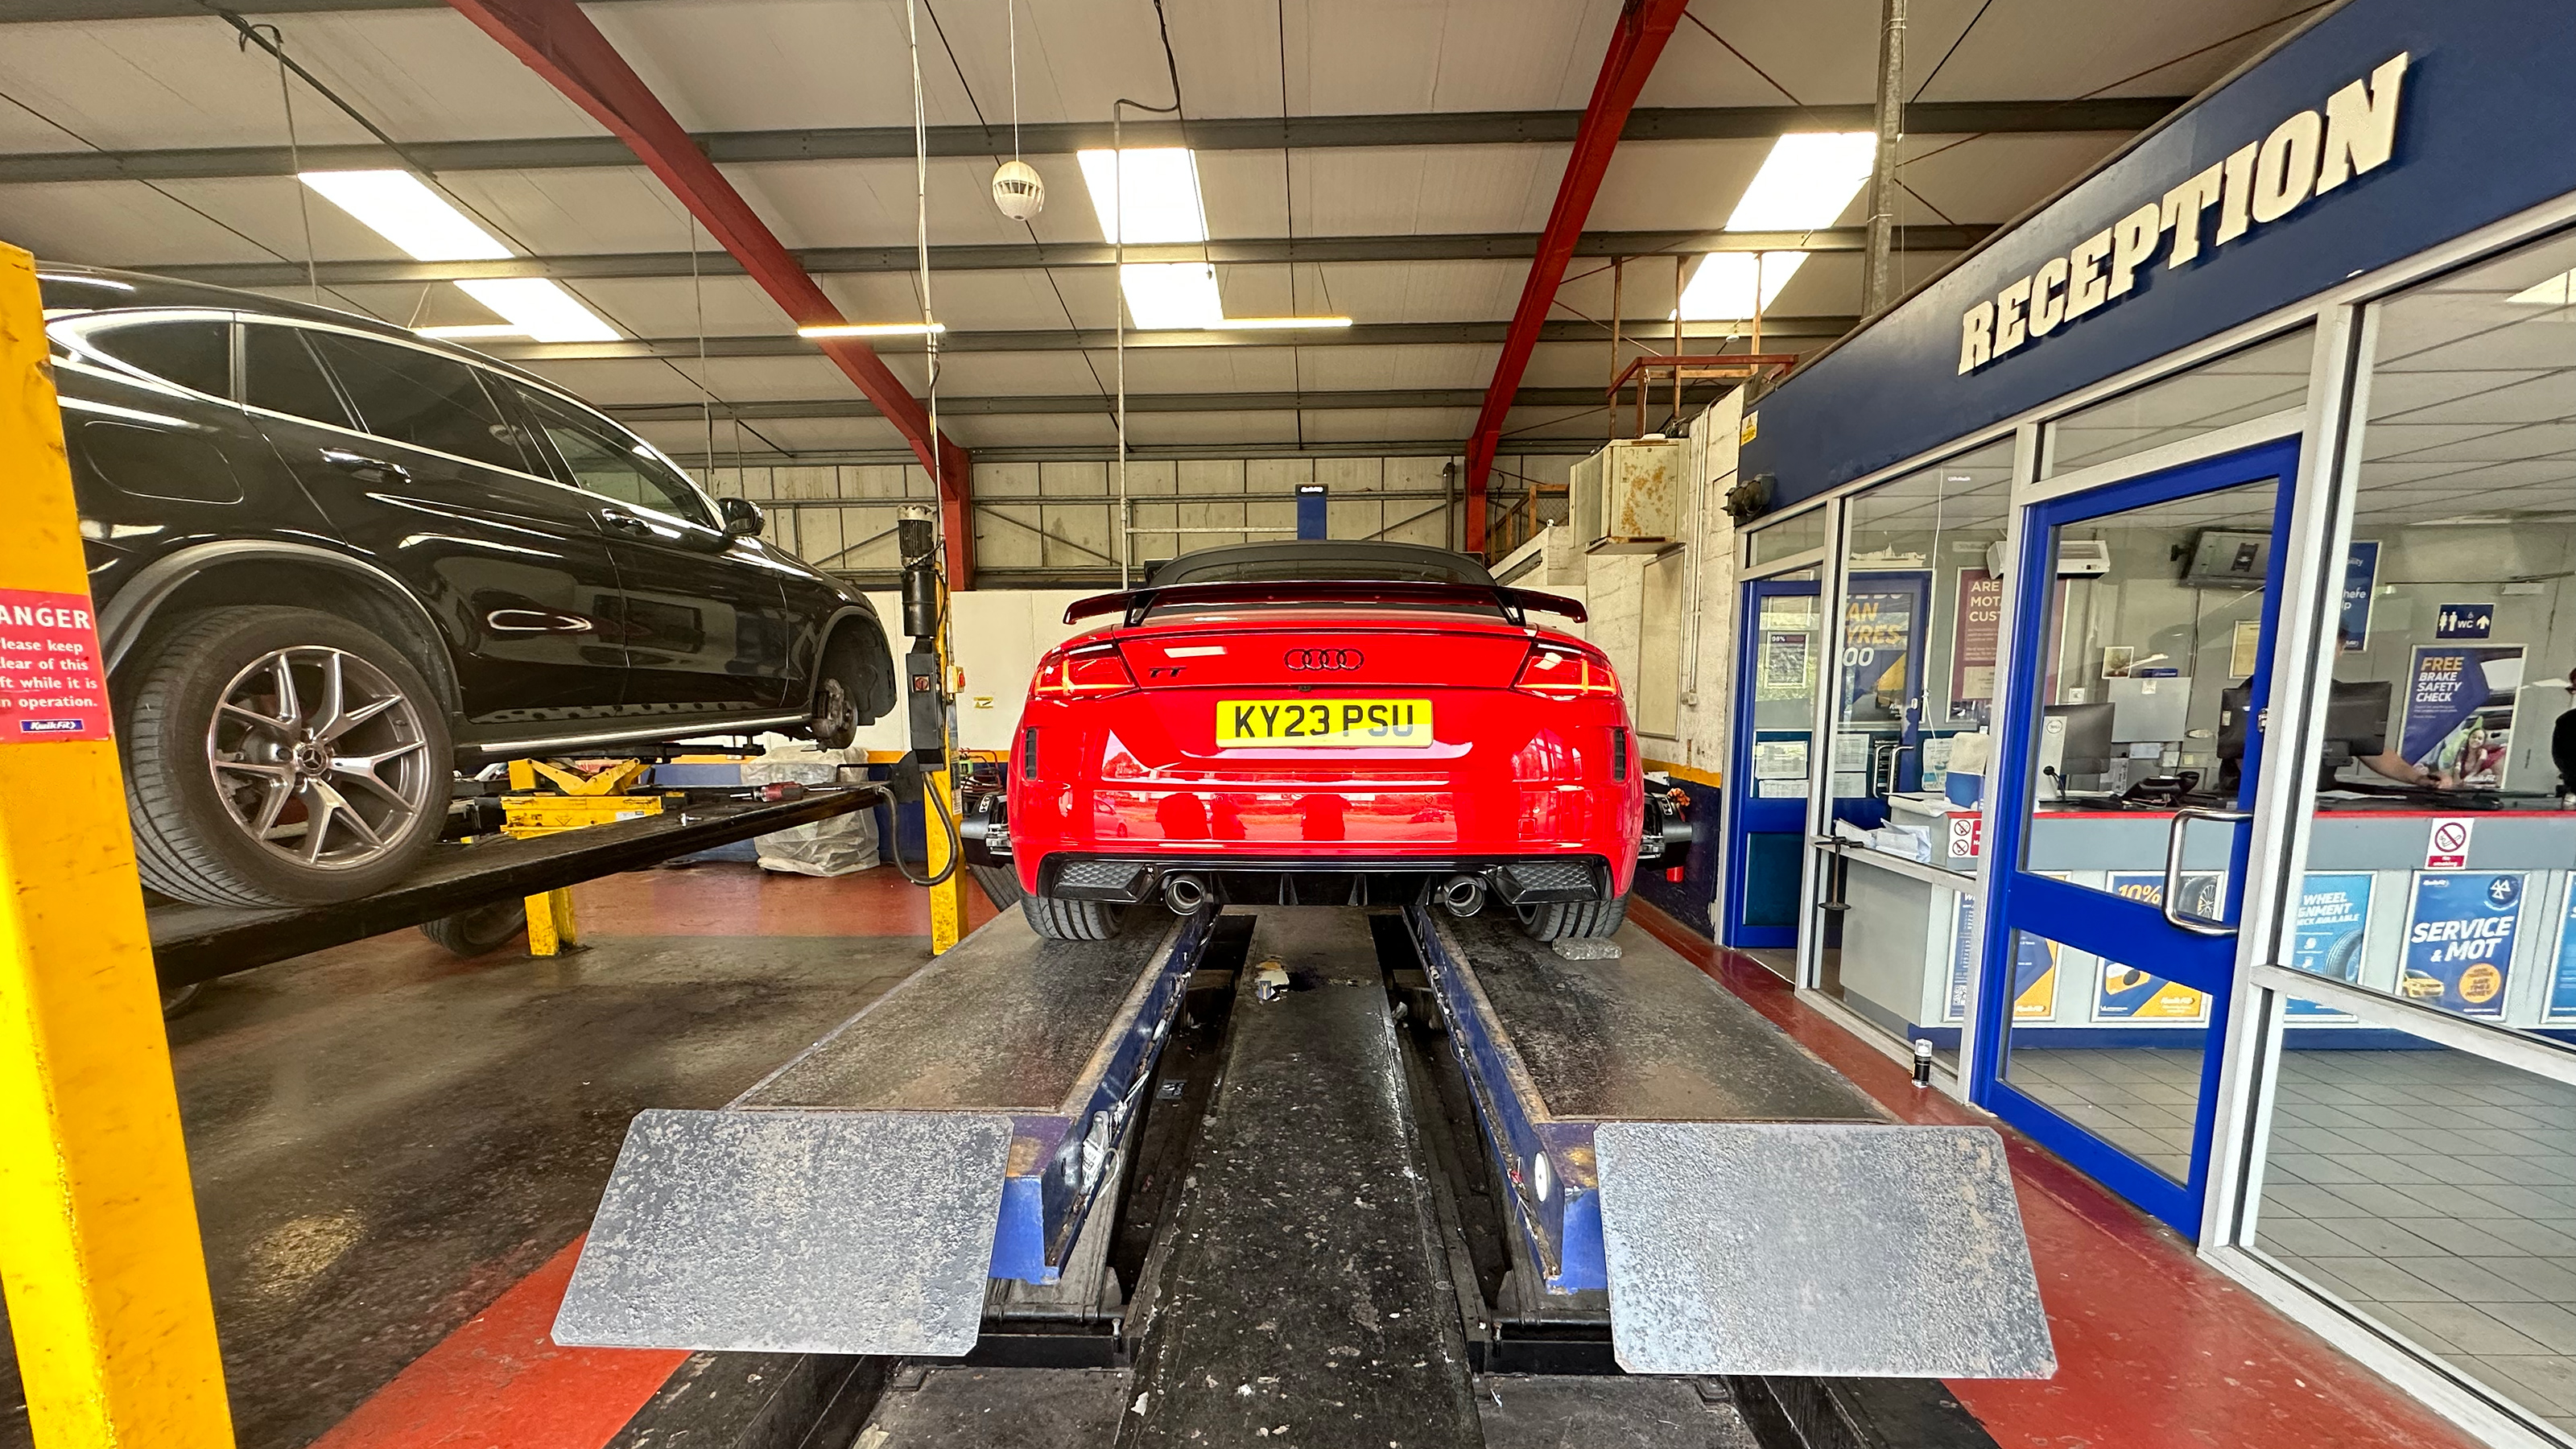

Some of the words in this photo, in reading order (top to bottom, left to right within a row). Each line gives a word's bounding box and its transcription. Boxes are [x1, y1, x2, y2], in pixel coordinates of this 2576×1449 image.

[1958, 51, 2409, 376] RECEPTION
[1971, 581, 2000, 592] ARE
[1970, 596, 2001, 607] MOT
[0, 605, 91, 630] ANGER
[1846, 602, 1879, 621] AN
[2458, 621, 2474, 629] WC
[1846, 624, 1901, 645] YRES
[0, 637, 42, 650] lease
[47, 639, 84, 655] keep
[0, 656, 32, 669] lear
[39, 658, 55, 670] of
[59, 658, 89, 671] this
[1843, 646, 1875, 667] OO
[2420, 656, 2465, 671] FREE
[1148, 666, 1188, 679] TT
[2418, 671, 2458, 682] BRAKE
[0, 675, 14, 688] ft
[19, 676, 62, 689] while
[66, 677, 80, 689] it
[85, 678, 97, 689] is
[2416, 681, 2463, 692] SAFETY
[19, 696, 98, 710] operation.
[2415, 692, 2453, 702] CHECK
[1234, 704, 1331, 738] KY23
[1342, 704, 1414, 737] PSU
[2303, 891, 2347, 906] WHEEL
[2297, 902, 2354, 918] GNMENT
[2314, 914, 2361, 925] AVAILABLE
[2411, 915, 2515, 943] SERVICE
[2430, 949, 2442, 963] &
[2444, 938, 2502, 962] MOT
